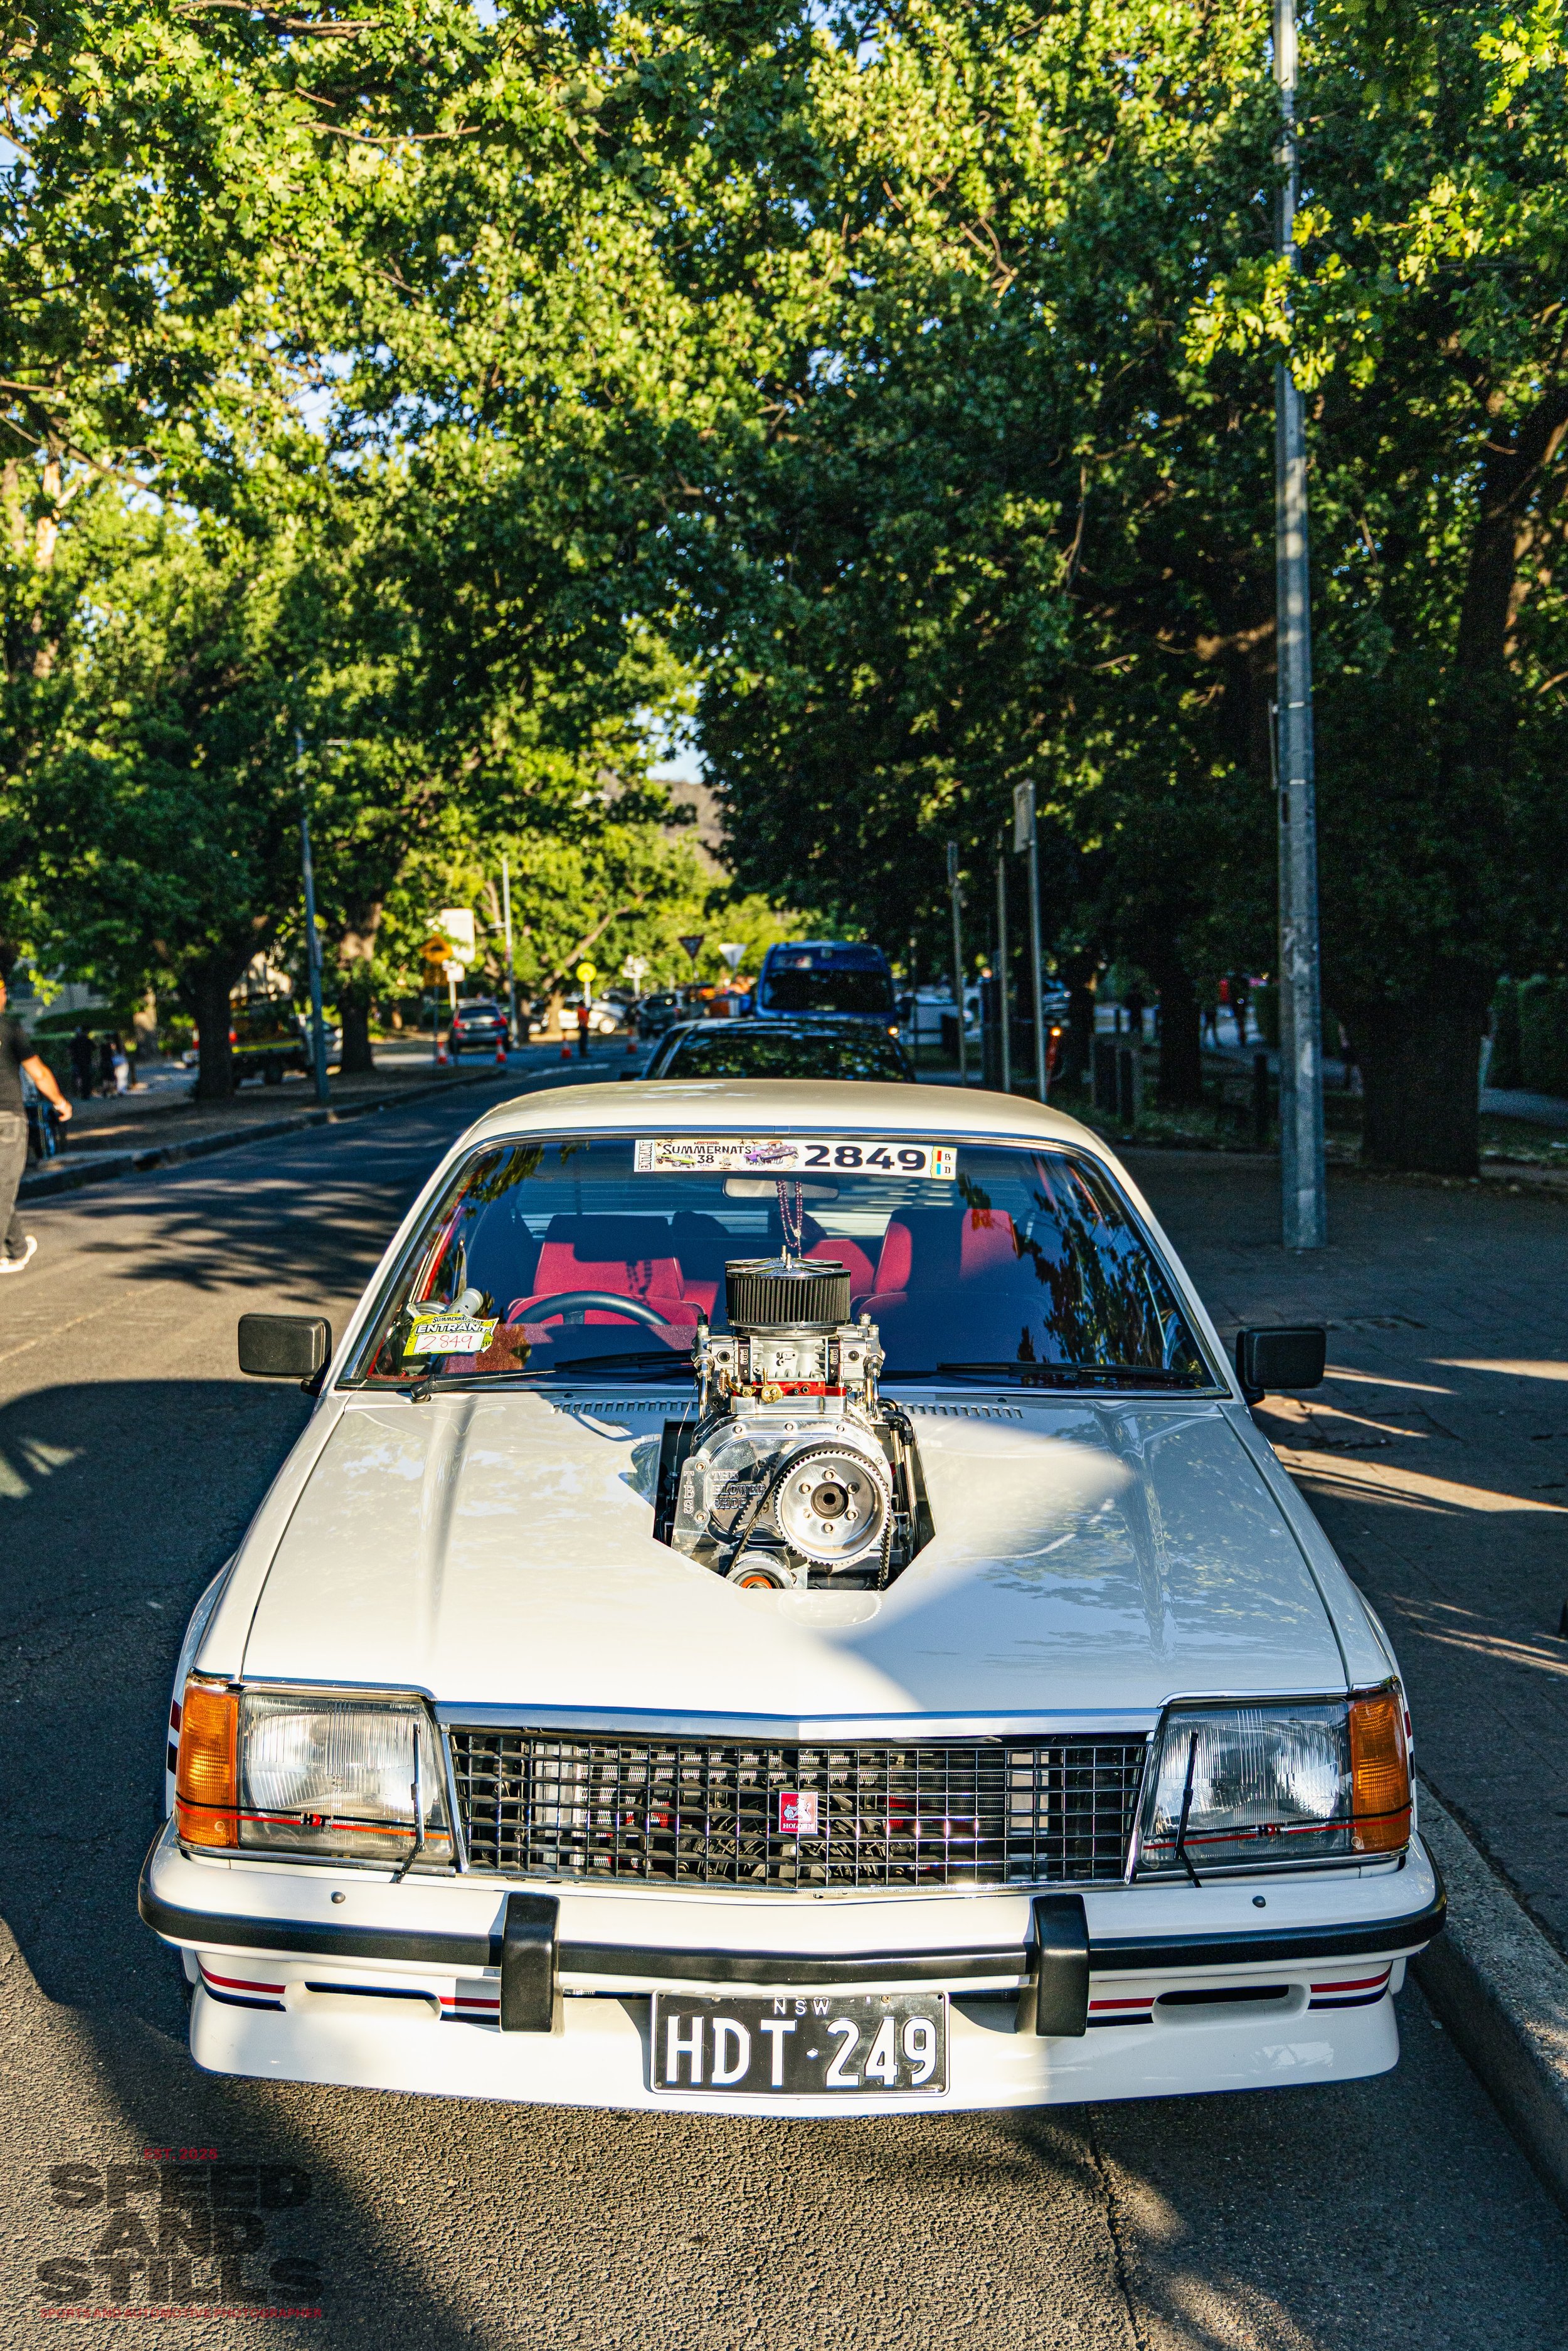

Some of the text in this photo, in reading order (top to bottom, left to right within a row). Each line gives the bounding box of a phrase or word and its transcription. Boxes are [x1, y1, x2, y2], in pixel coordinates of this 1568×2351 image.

[638, 1142, 652, 1170] ENTRANT
[662, 1144, 752, 1155] SUMMERNATS
[697, 1155, 714, 1164] 38
[804, 1145, 926, 1170] 2849
[416, 1322, 491, 1333] ENTRANT
[420, 1335, 473, 1350] 2849
[712, 1470, 739, 1481] THE
[684, 1471, 694, 1514] TBS
[712, 1484, 766, 1495] BLOWER
[713, 1497, 747, 1509] SHOP
[304, 1813, 331, 1827] HDT
[1258, 1823, 1285, 1836] HDT
[773, 1997, 829, 2015] NSW
